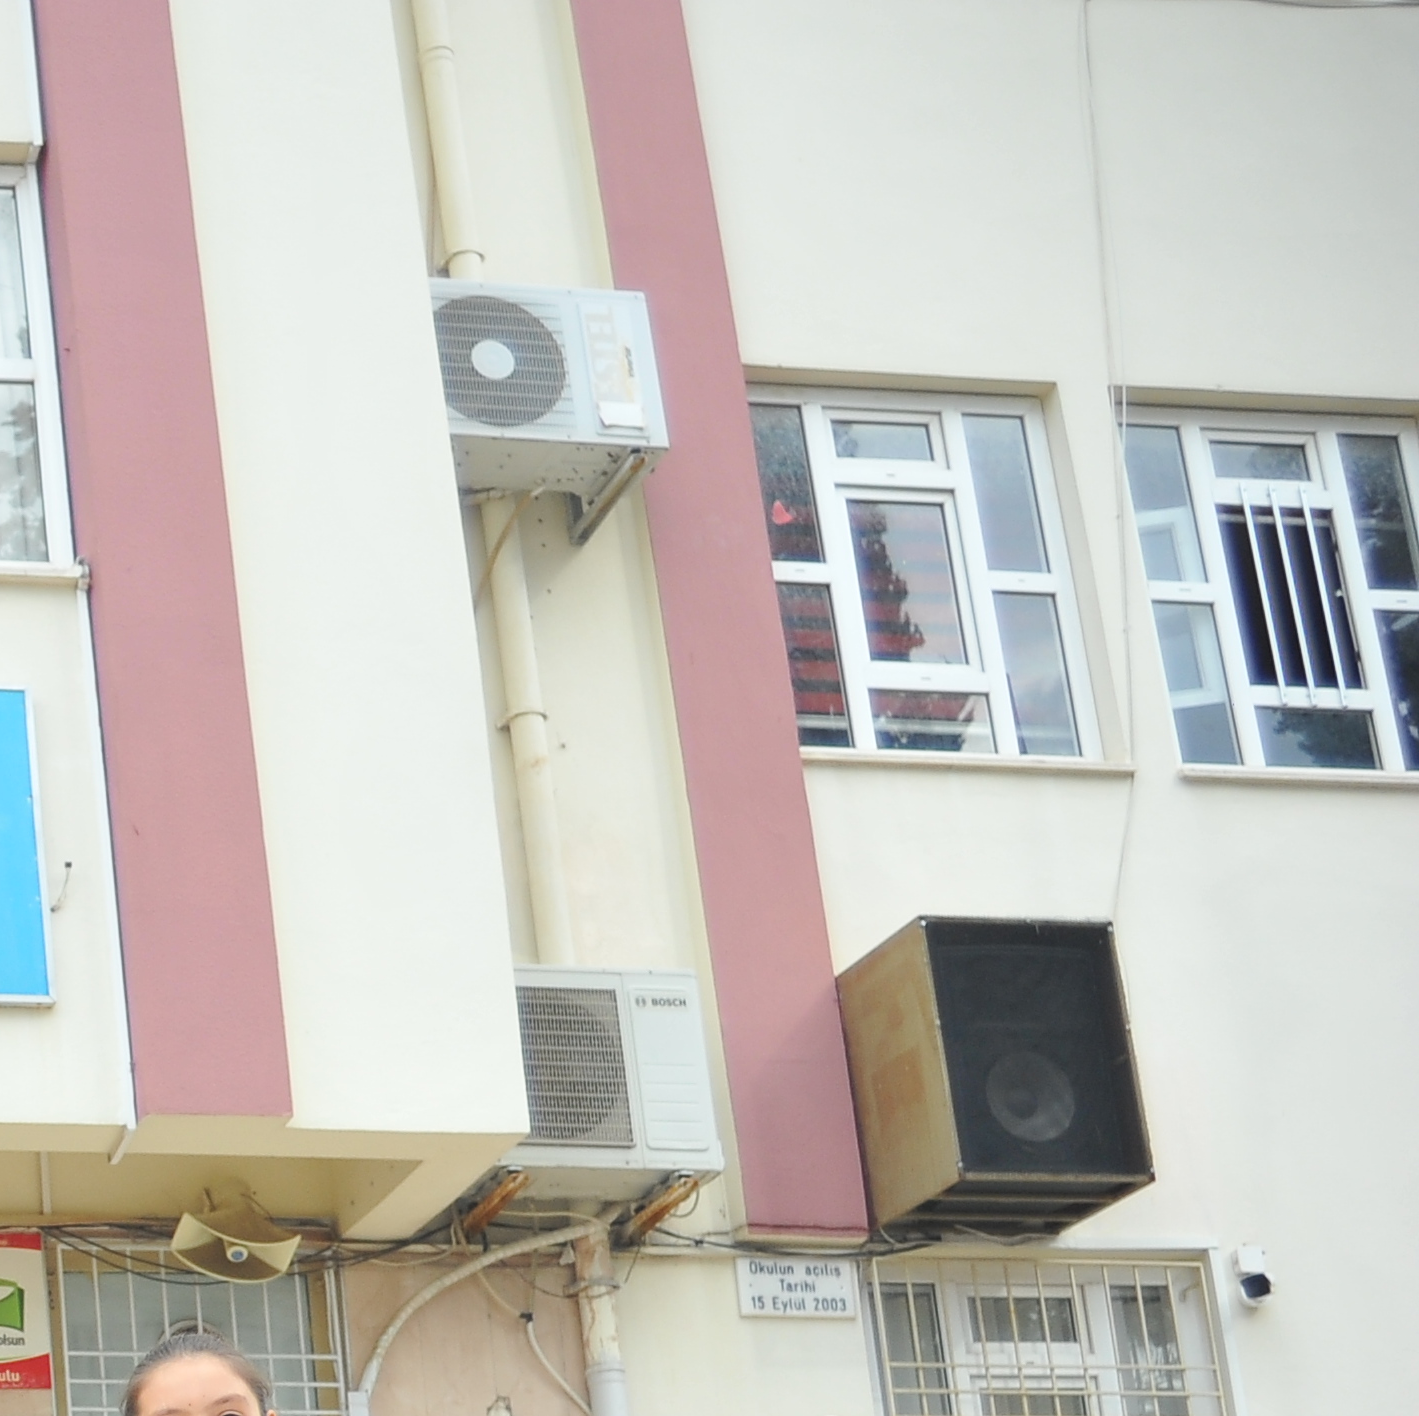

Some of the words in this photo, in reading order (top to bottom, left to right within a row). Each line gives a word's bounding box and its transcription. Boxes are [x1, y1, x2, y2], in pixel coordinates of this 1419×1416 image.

[651, 997, 687, 1007] BOSCH
[749, 1260, 794, 1275] Okulun
[780, 1279, 816, 1293] Tarihi
[751, 1296, 765, 1310] 15
[813, 1298, 847, 1312] 2003
